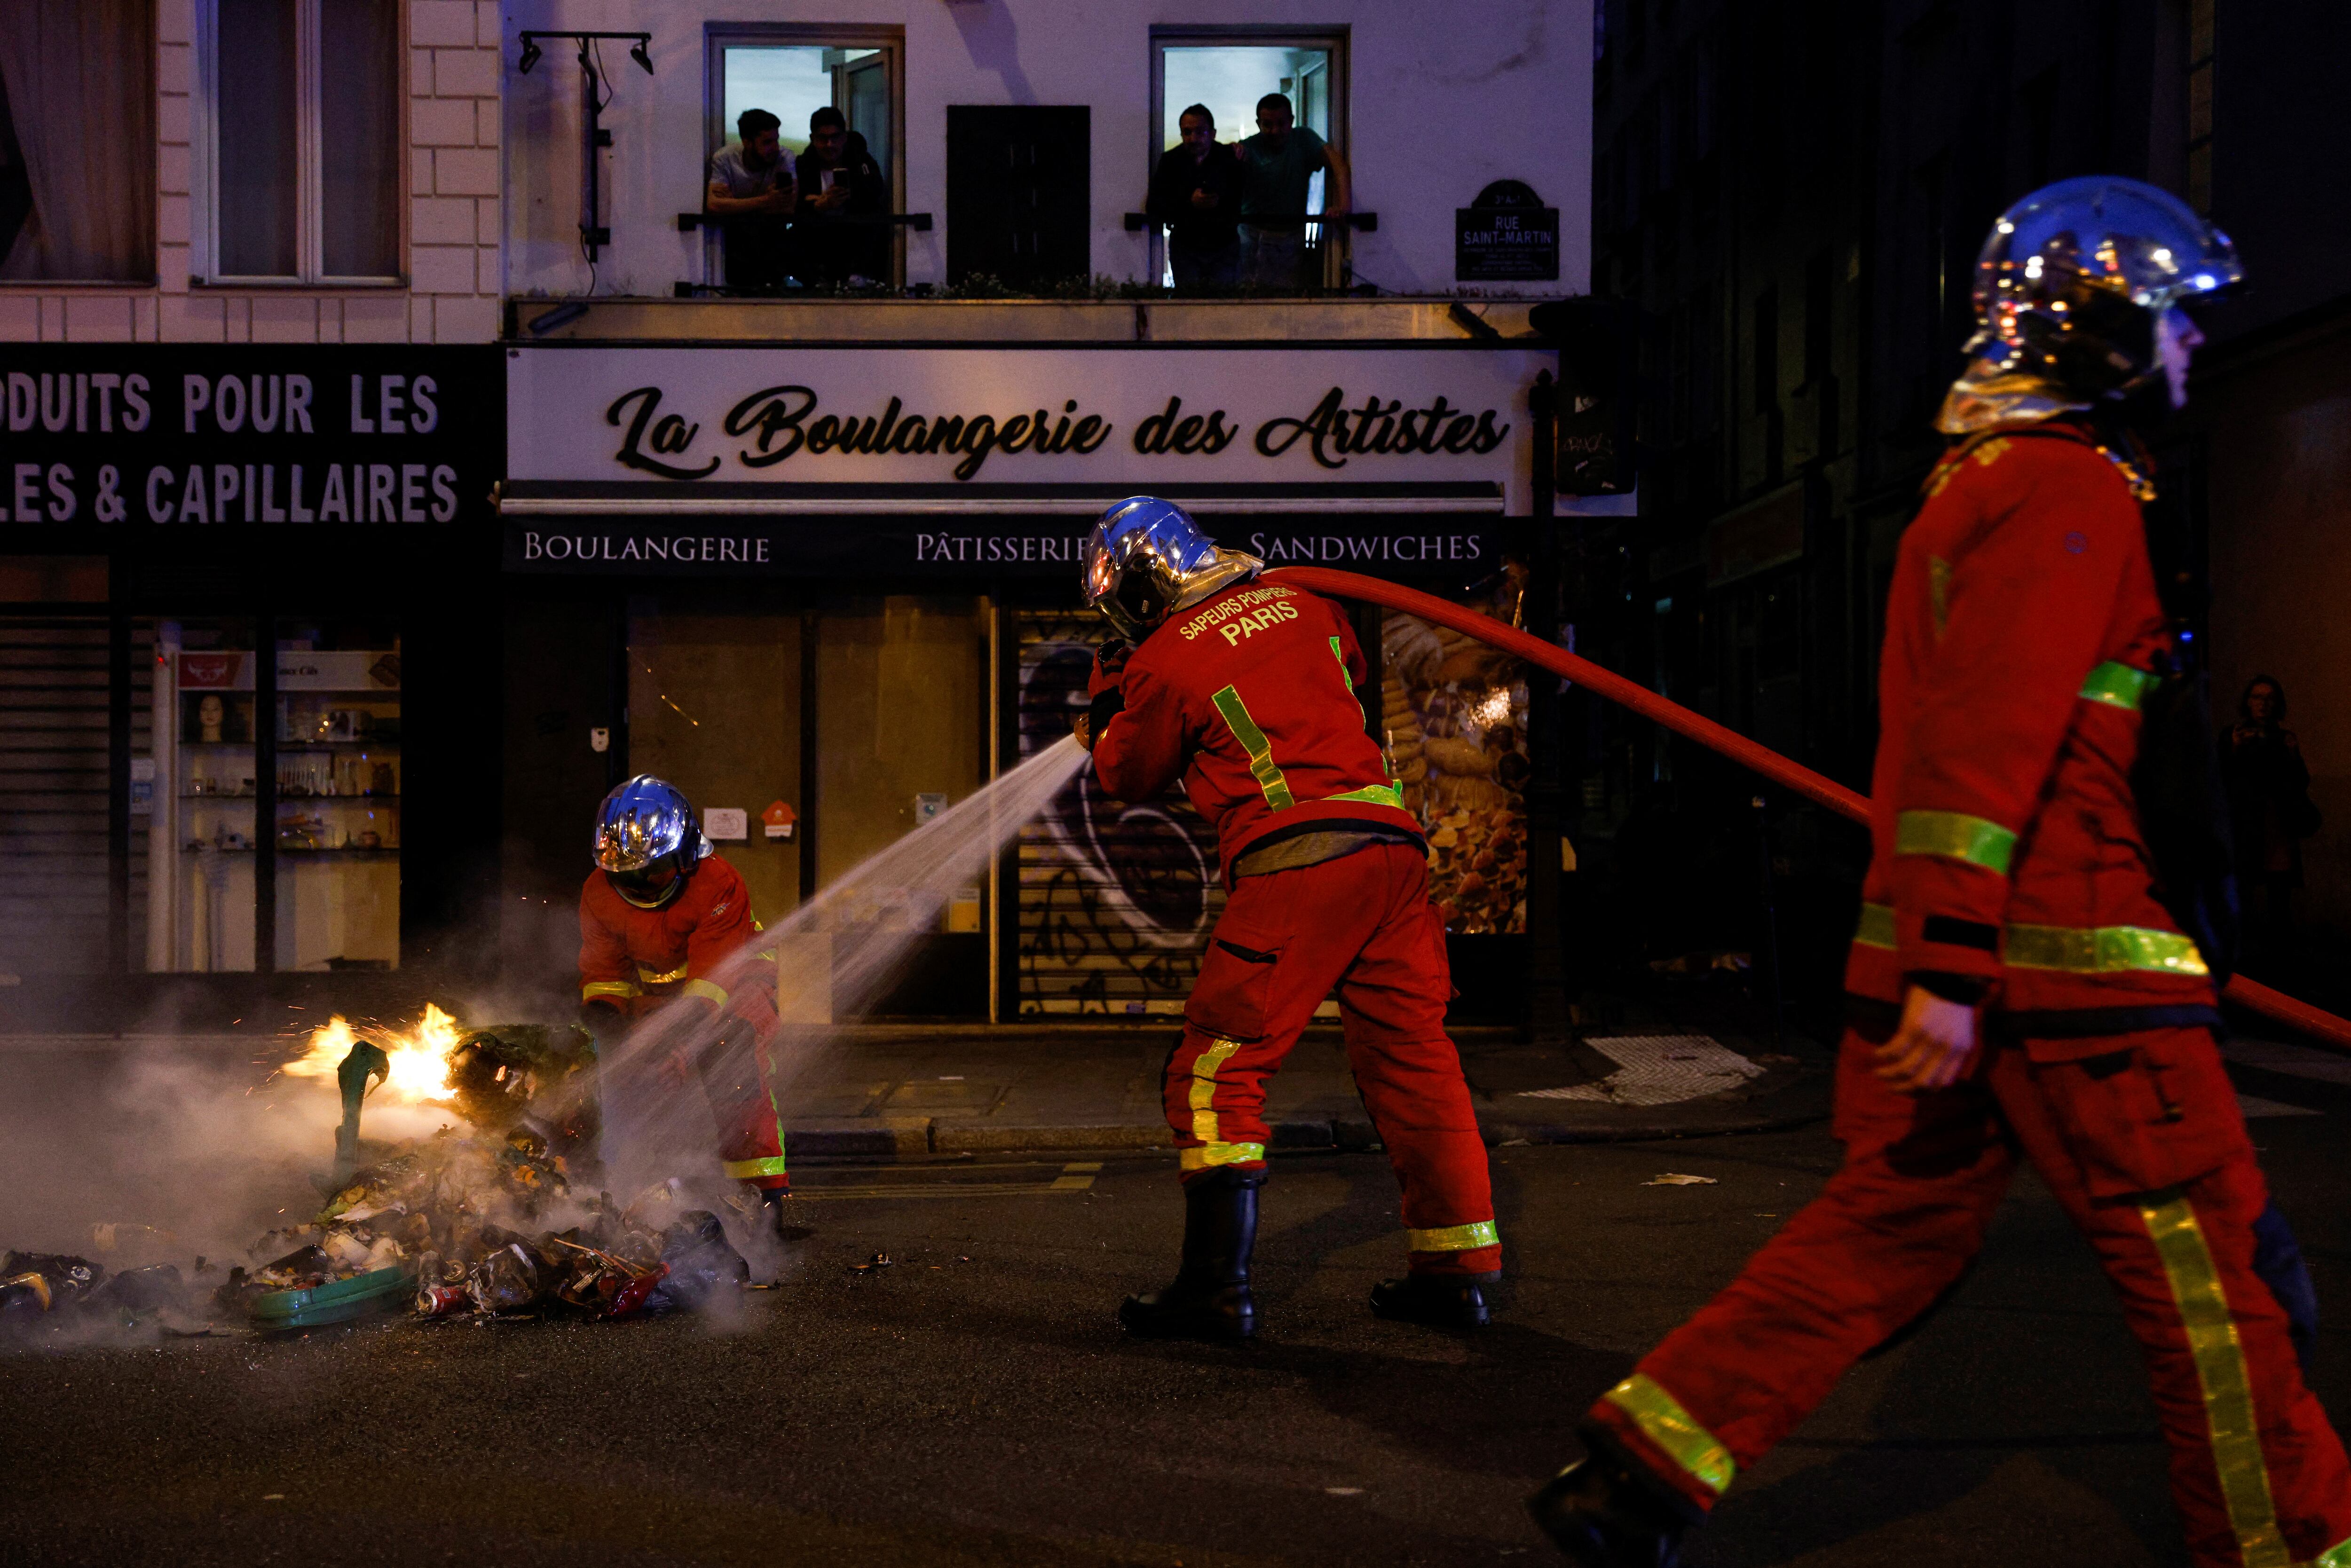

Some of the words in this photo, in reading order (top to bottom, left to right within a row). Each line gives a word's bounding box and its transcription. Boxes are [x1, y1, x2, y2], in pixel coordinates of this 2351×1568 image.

[1463, 230, 1552, 245] SAINT-MARTIN
[1495, 215, 1520, 230] RUE
[0, 372, 150, 433] DUITS
[183, 373, 314, 434] POUR
[350, 373, 438, 434] LES
[607, 386, 720, 480] La
[725, 385, 1112, 481] Boulangerie
[1132, 396, 1239, 455] des
[1254, 386, 1509, 469] Artistes
[94, 464, 127, 523] &
[146, 463, 458, 523] CAPILLAIRES
[524, 531, 770, 563] BOULANGERIE
[1250, 532, 1481, 562] SANDWICHES
[1179, 598, 1243, 640] SAPEURS
[1237, 587, 1297, 608] POMPIERS
[1219, 600, 1298, 646] PARIS
